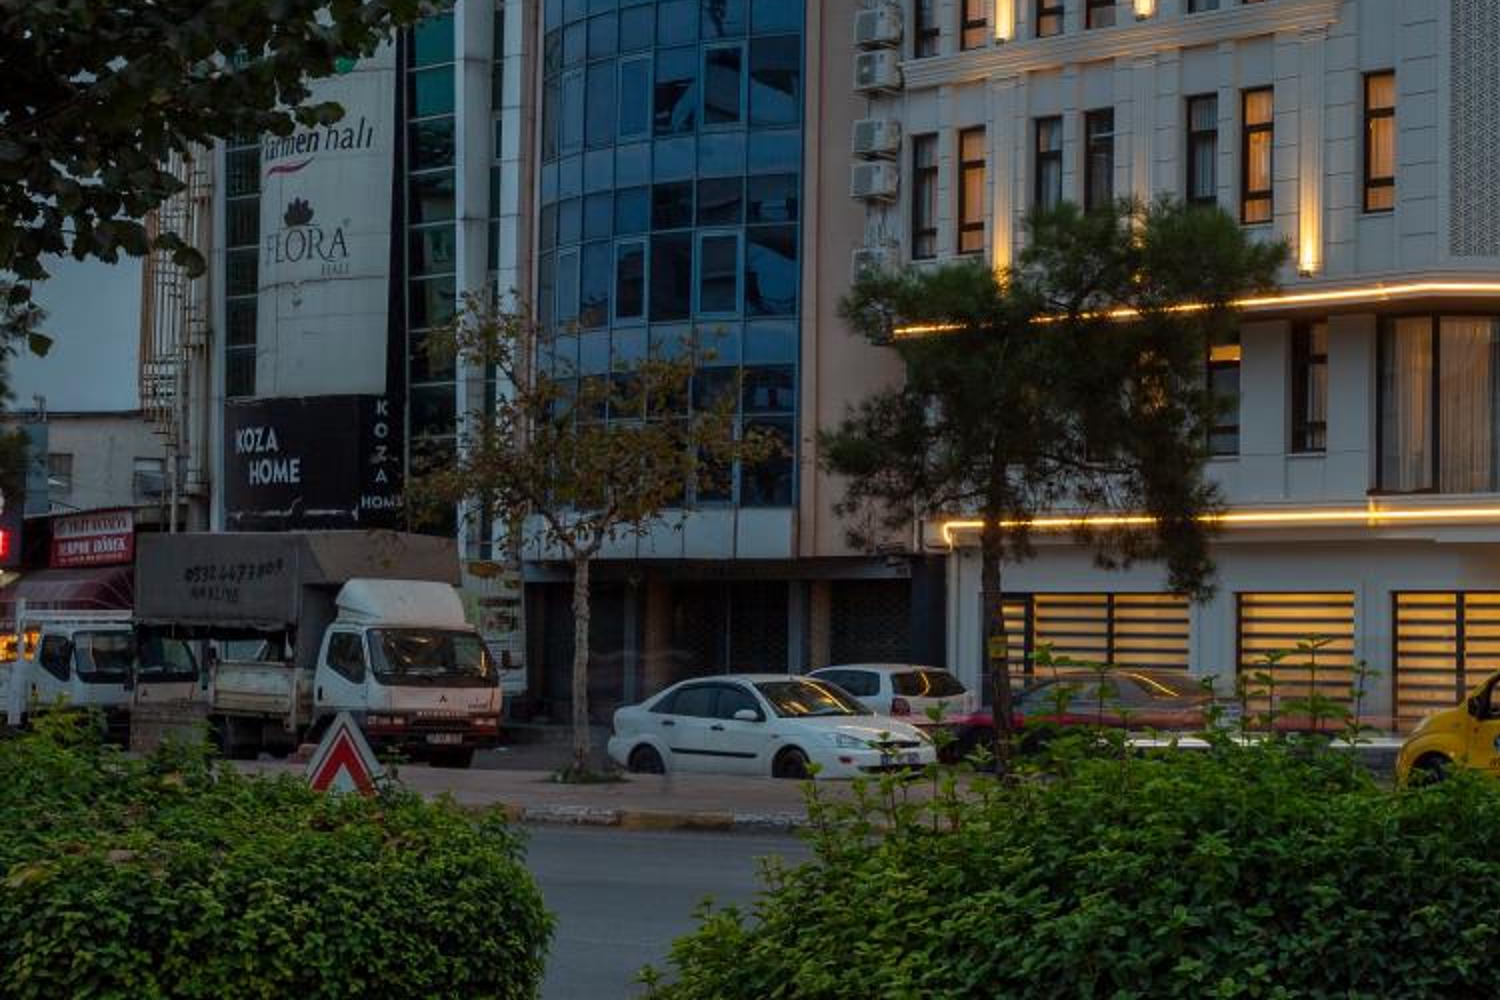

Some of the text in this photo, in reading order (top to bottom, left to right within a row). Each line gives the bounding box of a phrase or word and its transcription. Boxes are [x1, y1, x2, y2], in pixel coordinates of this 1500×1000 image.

[265, 226, 349, 266] FLORA
[235, 426, 280, 455] KOZA
[248, 456, 302, 486] HOME
